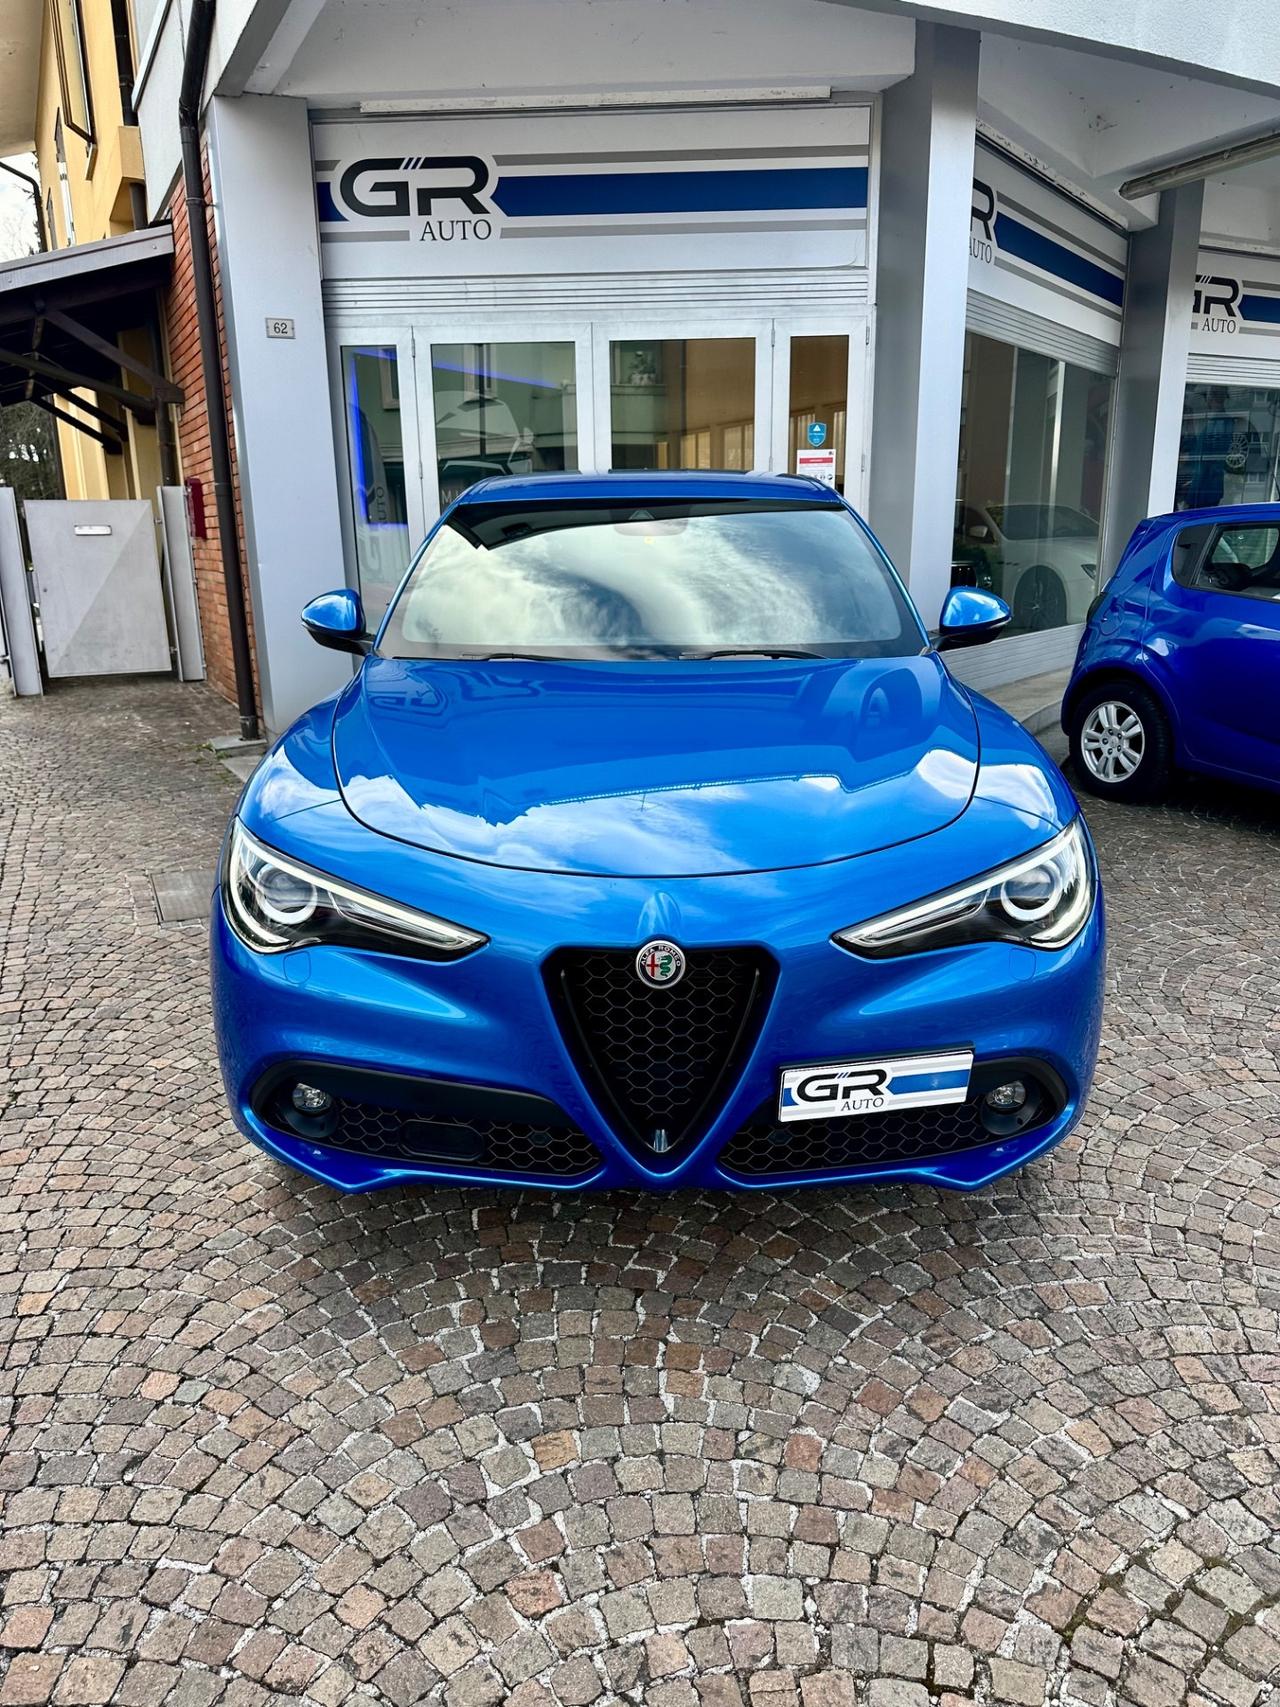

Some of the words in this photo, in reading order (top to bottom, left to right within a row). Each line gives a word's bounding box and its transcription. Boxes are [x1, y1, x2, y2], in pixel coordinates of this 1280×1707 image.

[340, 156, 491, 217] GR
[970, 177, 995, 241] R
[419, 219, 492, 242] AUTO
[273, 322, 289, 335] 62
[1202, 318, 1237, 334] AUTO
[658, 945, 681, 967] ROMEO
[797, 1069, 887, 1103] GR
[841, 1097, 884, 1112] AUTO
